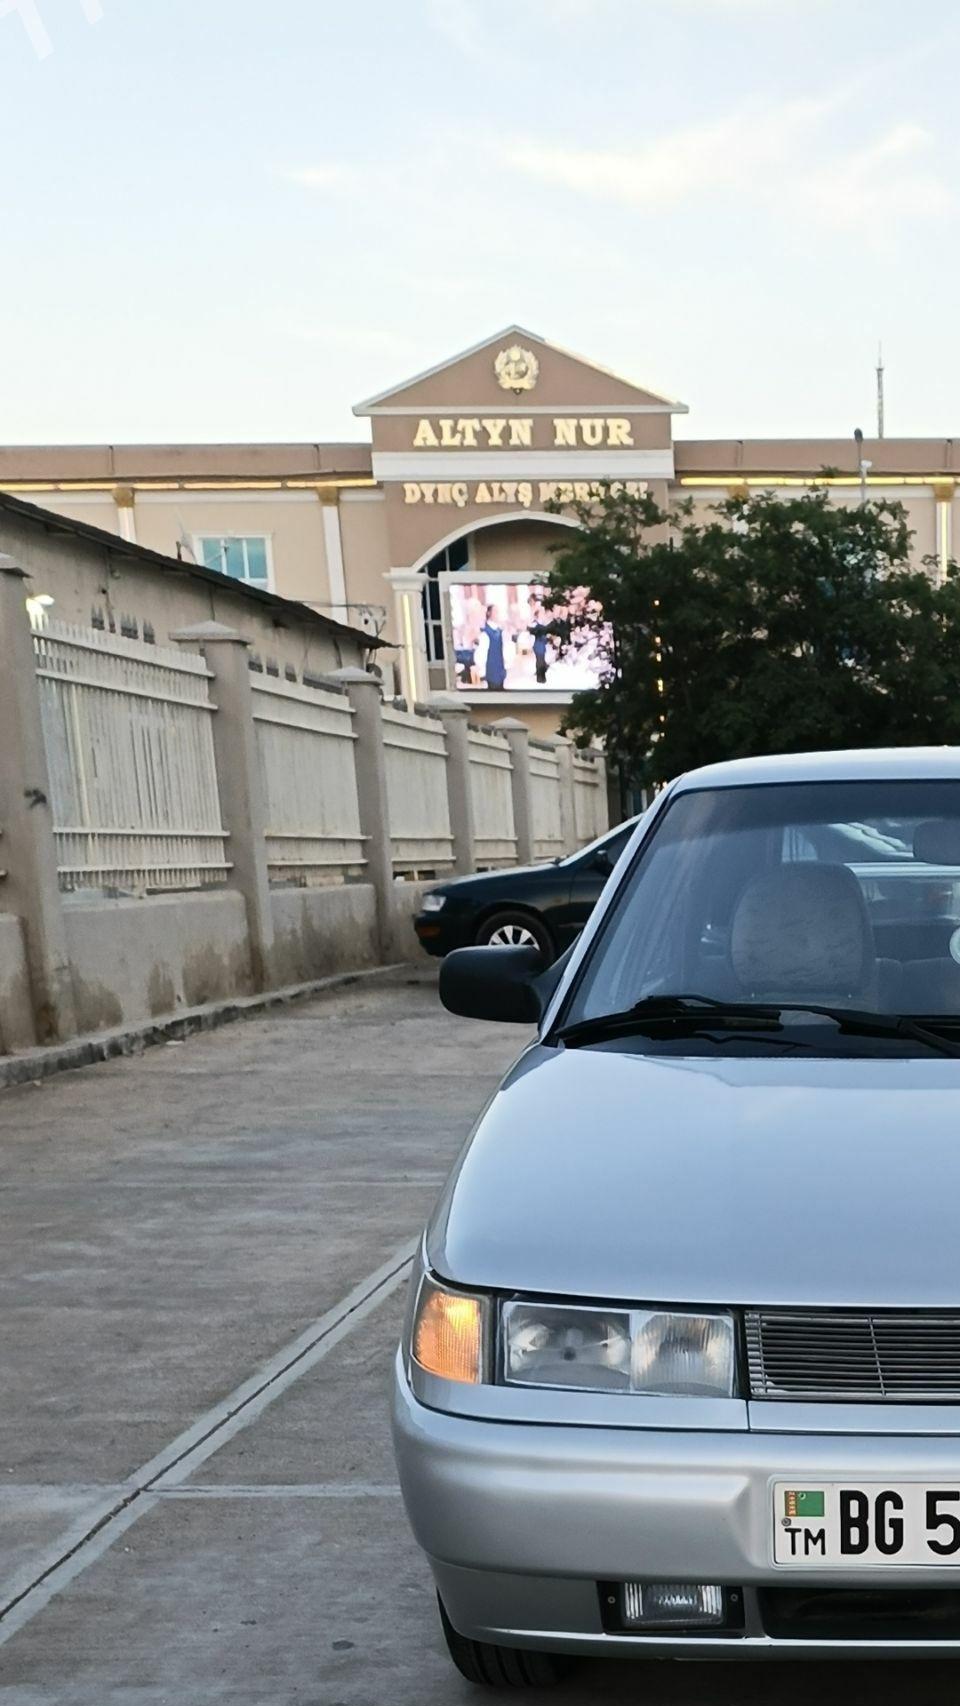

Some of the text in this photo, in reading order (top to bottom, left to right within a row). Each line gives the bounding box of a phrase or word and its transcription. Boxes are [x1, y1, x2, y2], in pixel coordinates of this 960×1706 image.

[413, 417, 634, 447] ALTYN NUR
[784, 1527, 826, 1556] TM
[839, 1490, 904, 1555] BG
